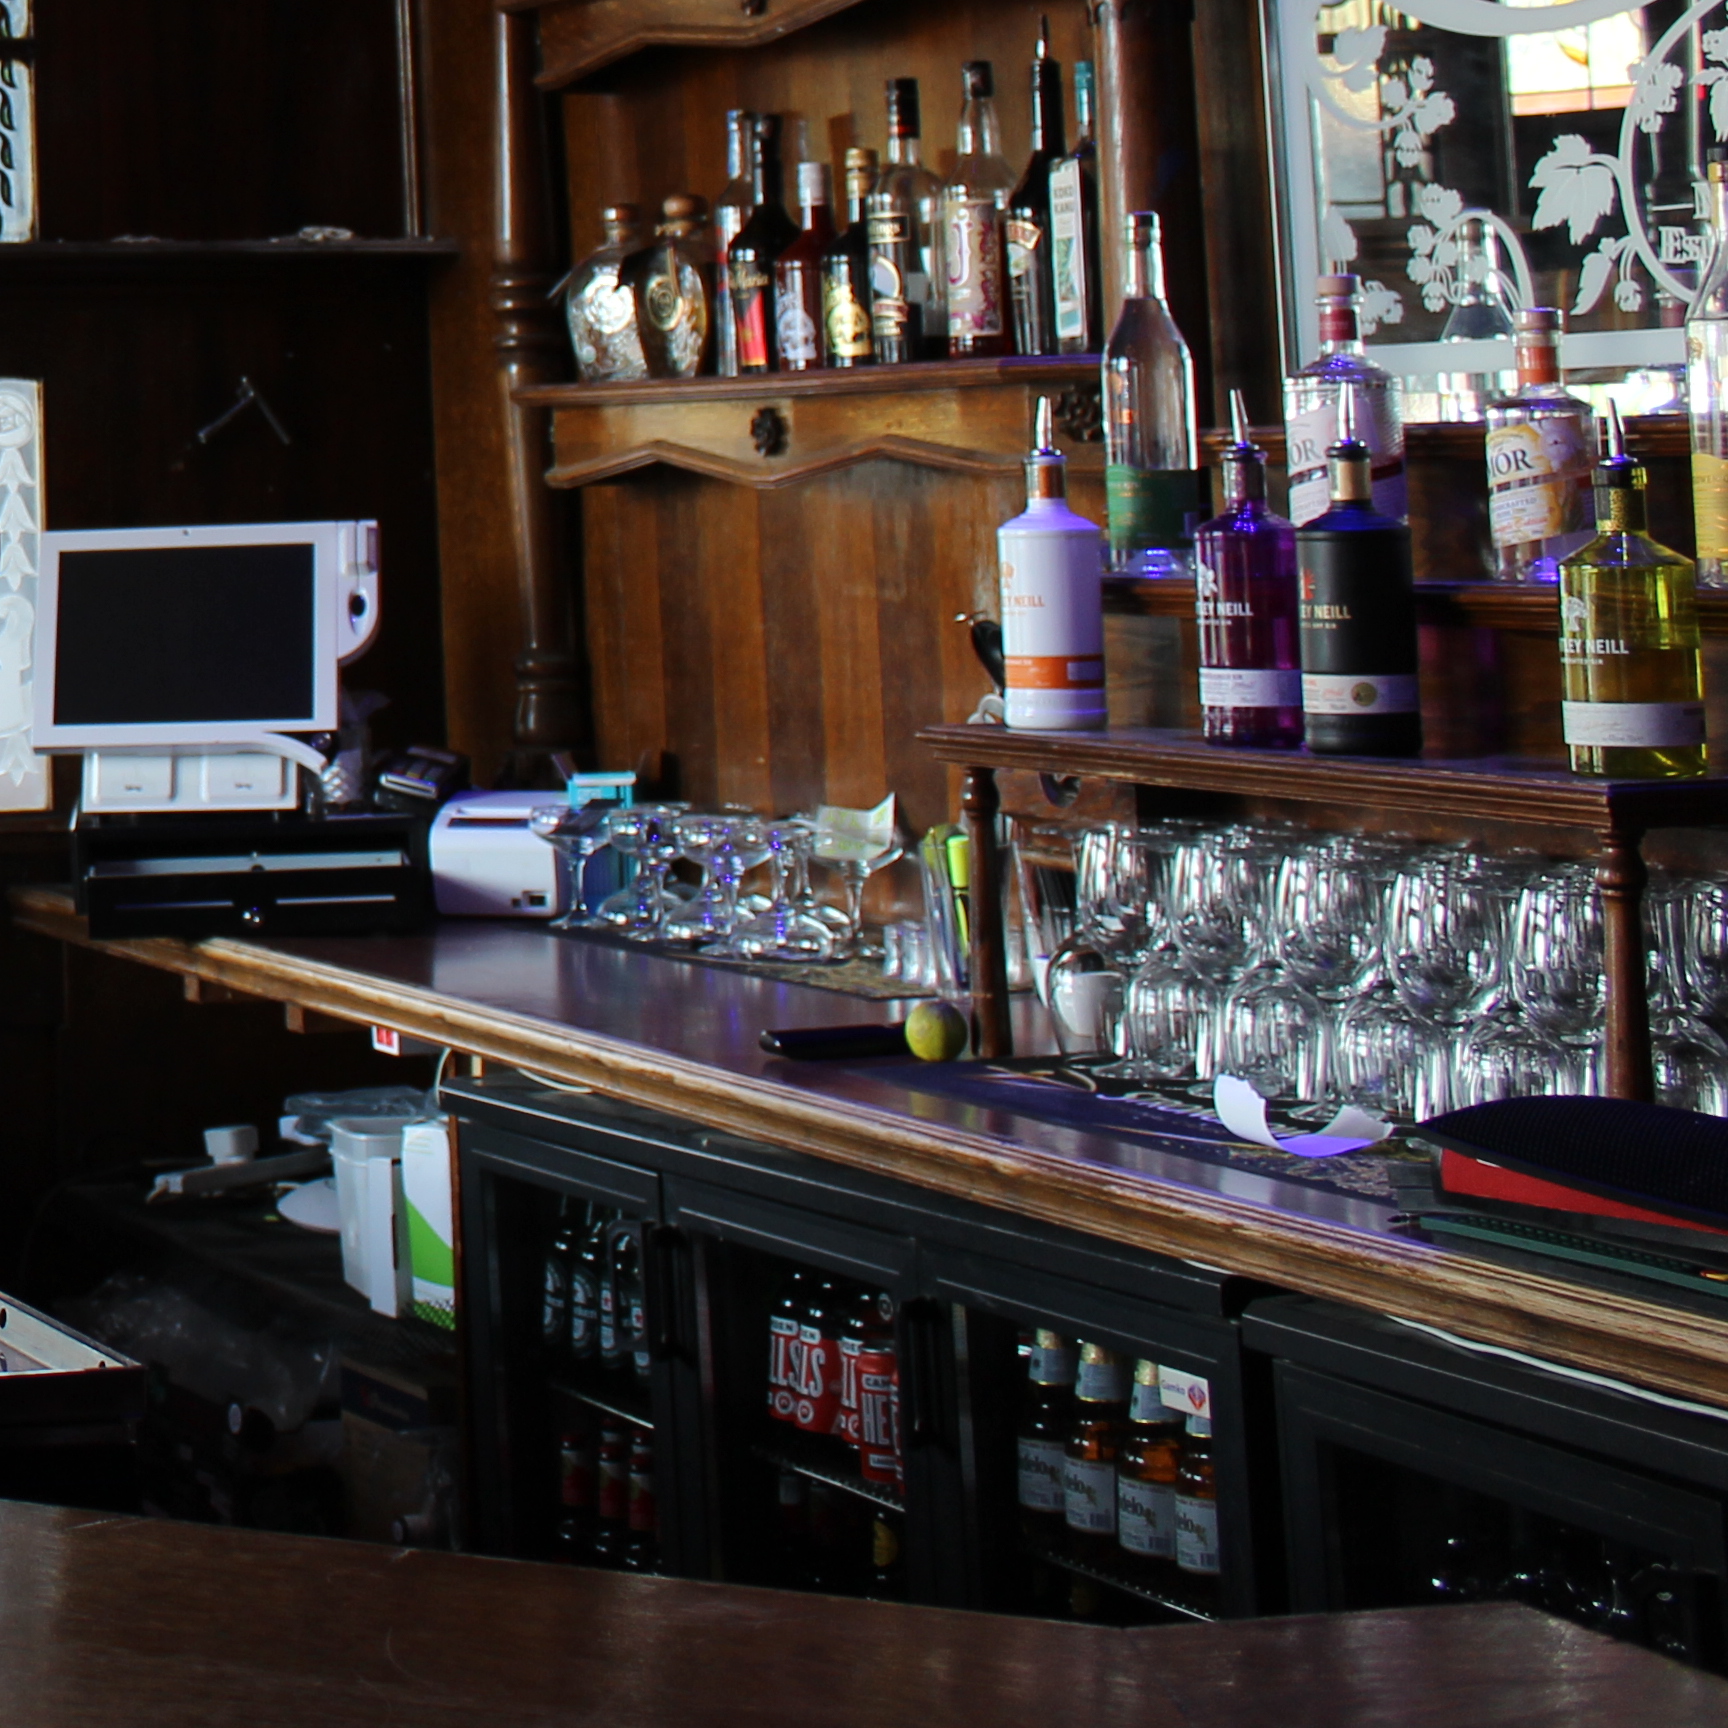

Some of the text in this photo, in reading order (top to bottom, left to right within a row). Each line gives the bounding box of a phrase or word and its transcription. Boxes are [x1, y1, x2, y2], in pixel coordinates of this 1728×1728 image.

[1216, 603, 1254, 616] NEILL
[1314, 605, 1352, 620] NEILL
[1585, 638, 1629, 655] NEILL
